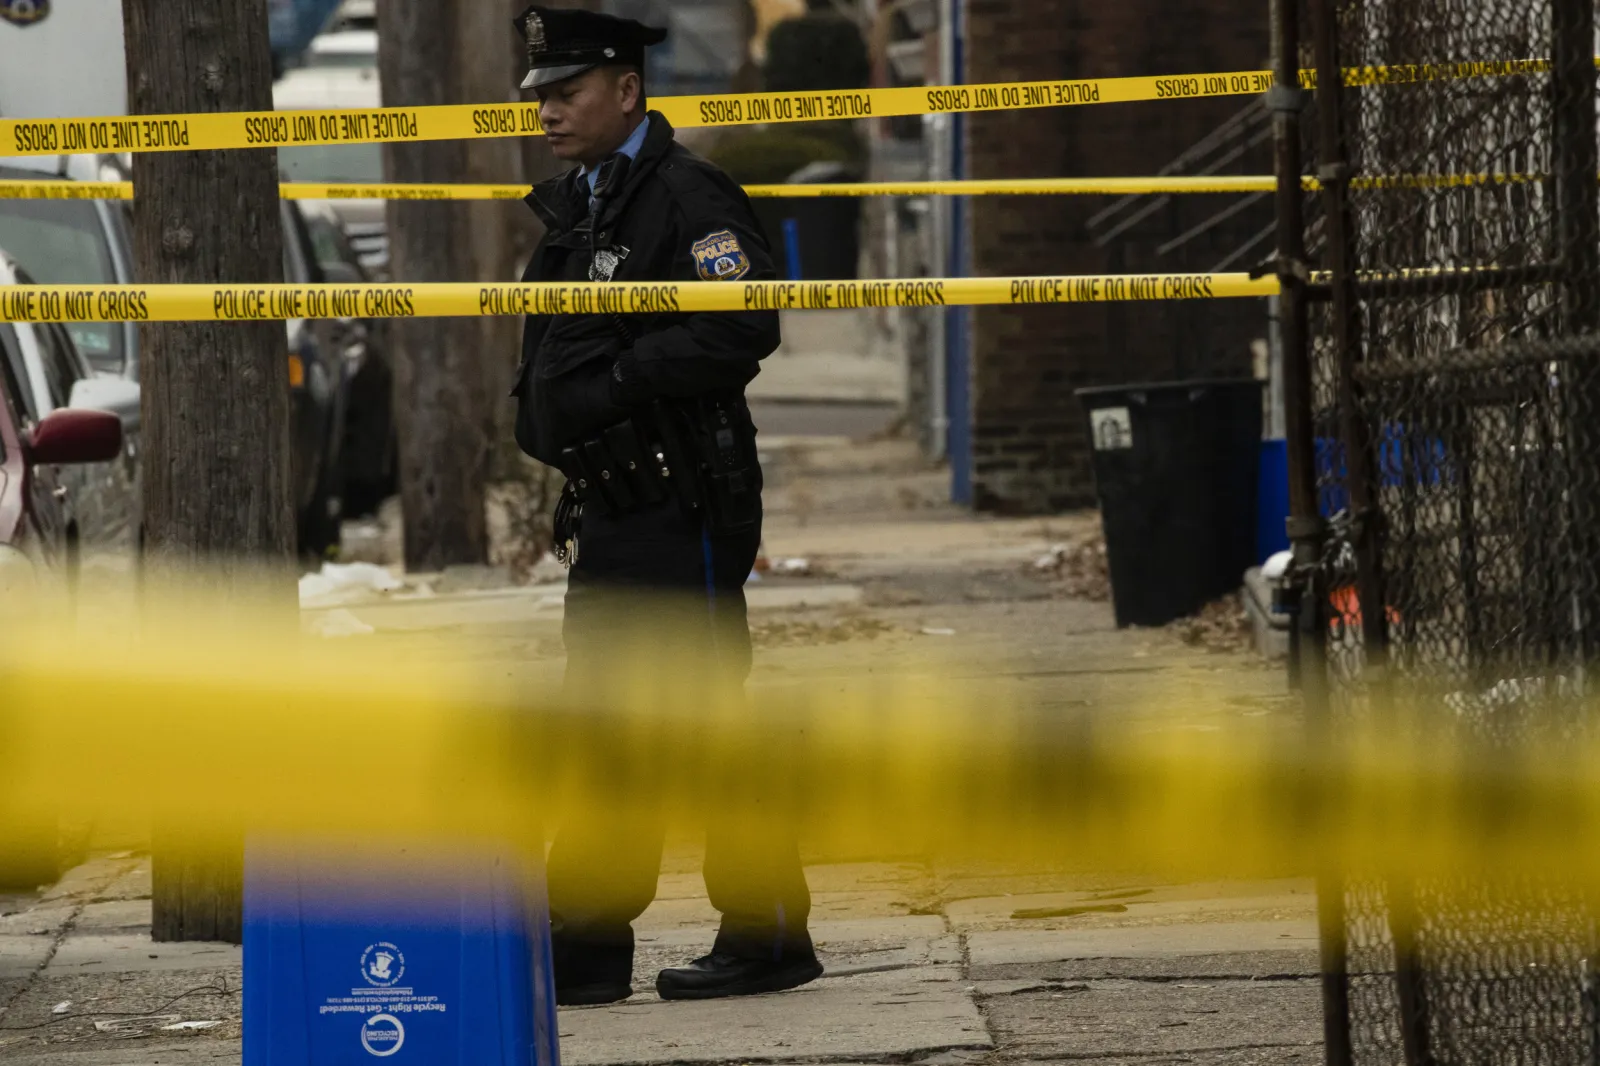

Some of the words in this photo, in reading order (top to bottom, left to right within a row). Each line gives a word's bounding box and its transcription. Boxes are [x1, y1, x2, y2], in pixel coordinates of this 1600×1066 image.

[1054, 84, 1099, 103] POLICE
[1156, 79, 1198, 97] CROSS
[1204, 77, 1227, 94] NOT
[1231, 76, 1249, 92] DO
[1252, 74, 1274, 91] INE
[795, 97, 823, 118] LINE
[826, 95, 871, 116] POLICE
[928, 89, 969, 111] CROSS
[975, 88, 998, 108] NOT
[1002, 87, 1020, 107] DO
[1023, 86, 1051, 105] LINE
[700, 100, 742, 123] CROSS
[747, 99, 770, 121] NOT
[774, 98, 792, 119] DO
[245, 117, 288, 143] CROSS
[293, 116, 316, 142] NOT
[320, 115, 338, 140] DO
[341, 114, 369, 139] LINE
[372, 113, 417, 138] POLICE
[472, 109, 515, 133] CROSS
[14, 124, 57, 151] CROSS
[62, 123, 87, 150] NOT
[90, 122, 108, 149] DO
[111, 121, 140, 148] LINE
[143, 120, 190, 147] POLICE
[697, 239, 739, 263] POLICE
[480, 288, 532, 314] POLICE
[535, 288, 568, 314] LINE
[572, 288, 593, 313] DO
[597, 287, 625, 313] NOT
[630, 286, 680, 312] CROSS
[745, 285, 796, 309] POLICE
[801, 284, 832, 308] LINE
[837, 284, 858, 308] DO
[862, 283, 890, 307] NOT
[895, 282, 945, 306] CROSS
[1011, 280, 1062, 302] POLICE
[1066, 279, 1099, 300] LINE
[1105, 279, 1125, 299] DO
[1130, 278, 1158, 298] NOT
[1163, 277, 1213, 298] CROSS
[2, 291, 37, 320] LINE
[40, 291, 61, 320] DO
[65, 291, 93, 320] NOT
[98, 291, 148, 319] CROSS
[213, 290, 267, 318] POLICE
[270, 290, 303, 318] LINE
[307, 290, 328, 317] DO
[332, 290, 360, 317] NOT
[365, 289, 414, 316] CROSS
[389, 1003, 412, 1012] Right
[413, 1003, 446, 1012] Recycle
